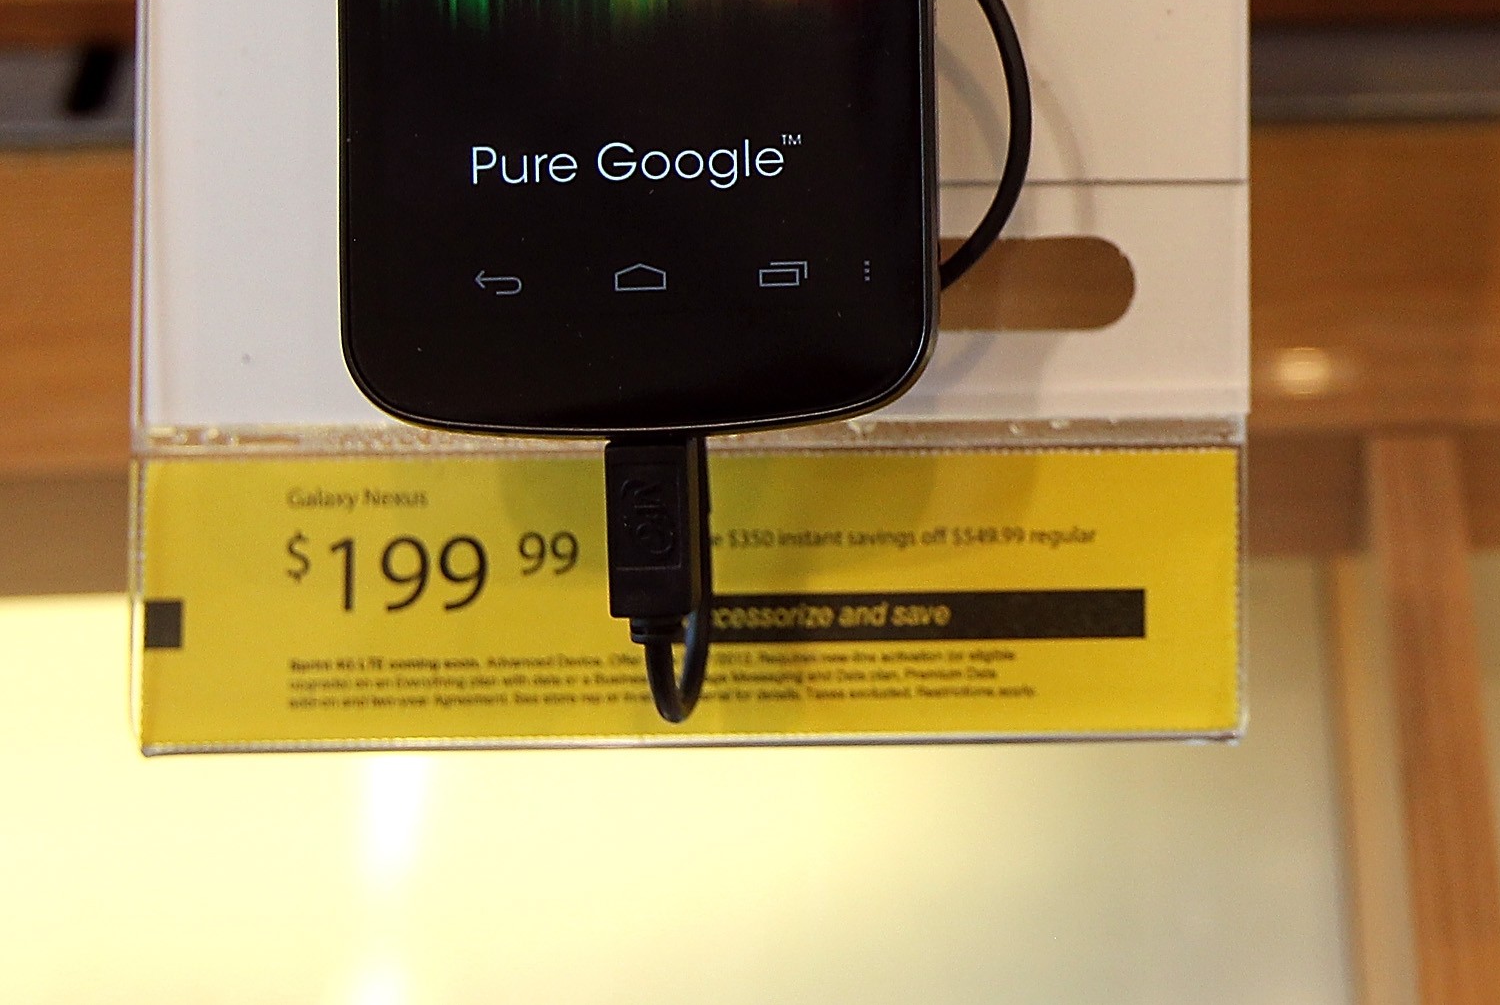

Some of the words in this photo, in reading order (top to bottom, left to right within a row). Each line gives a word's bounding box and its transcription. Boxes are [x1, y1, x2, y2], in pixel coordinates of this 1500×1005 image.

[471, 145, 579, 185] Pure
[286, 487, 361, 510] Galaxy
[365, 488, 429, 508] Nexus
[517, 529, 581, 577] 99
[778, 528, 842, 548] instant
[847, 528, 915, 553] savings
[921, 525, 949, 547] off
[1029, 527, 1097, 554] regular
[839, 600, 888, 628] and
[892, 602, 952, 628] save
